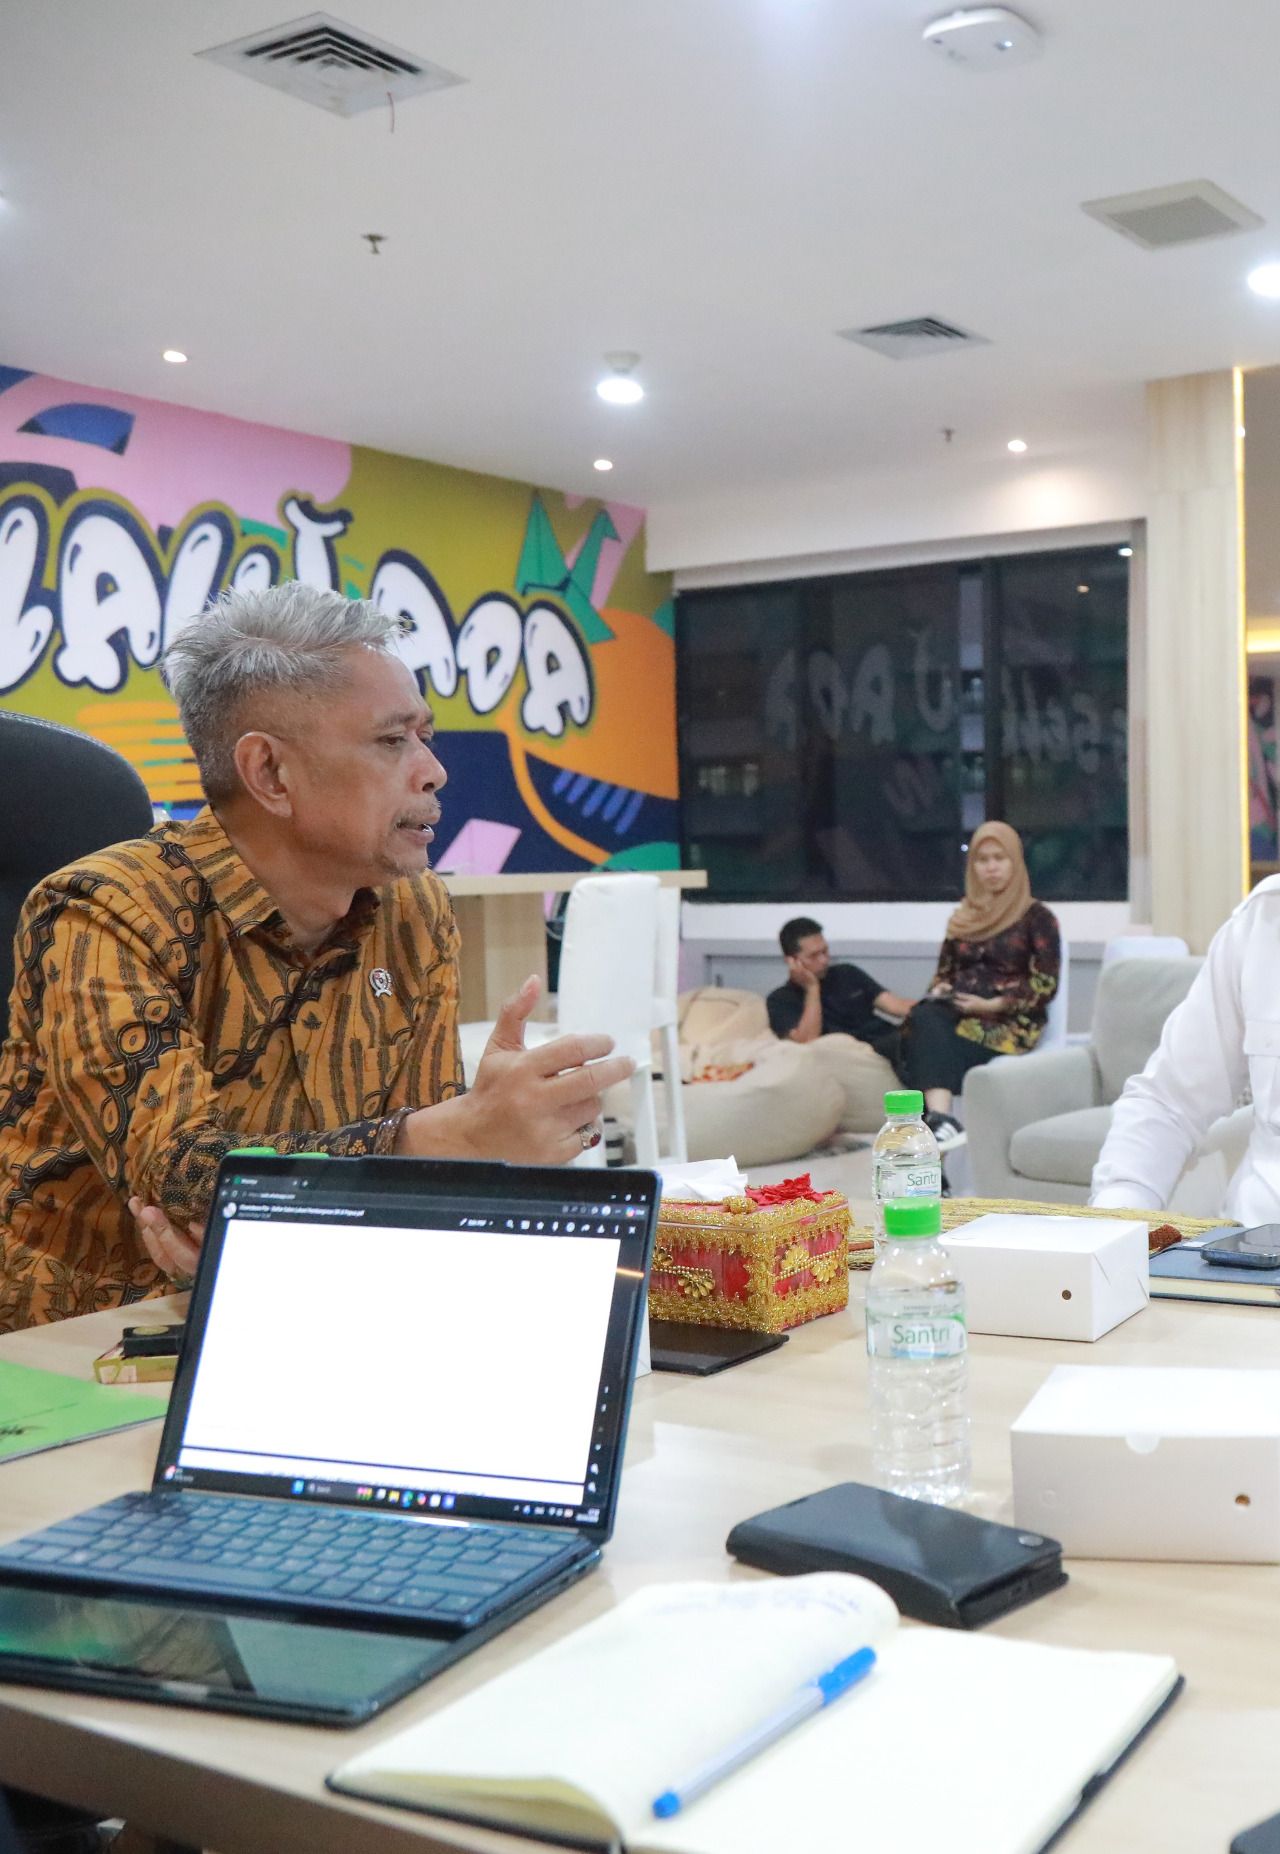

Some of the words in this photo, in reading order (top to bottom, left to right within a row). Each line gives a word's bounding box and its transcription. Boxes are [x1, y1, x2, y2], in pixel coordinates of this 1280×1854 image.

[369, 547, 594, 738] ADA
[907, 1173, 937, 1187] Santr
[892, 1324, 950, 1345] Santri
